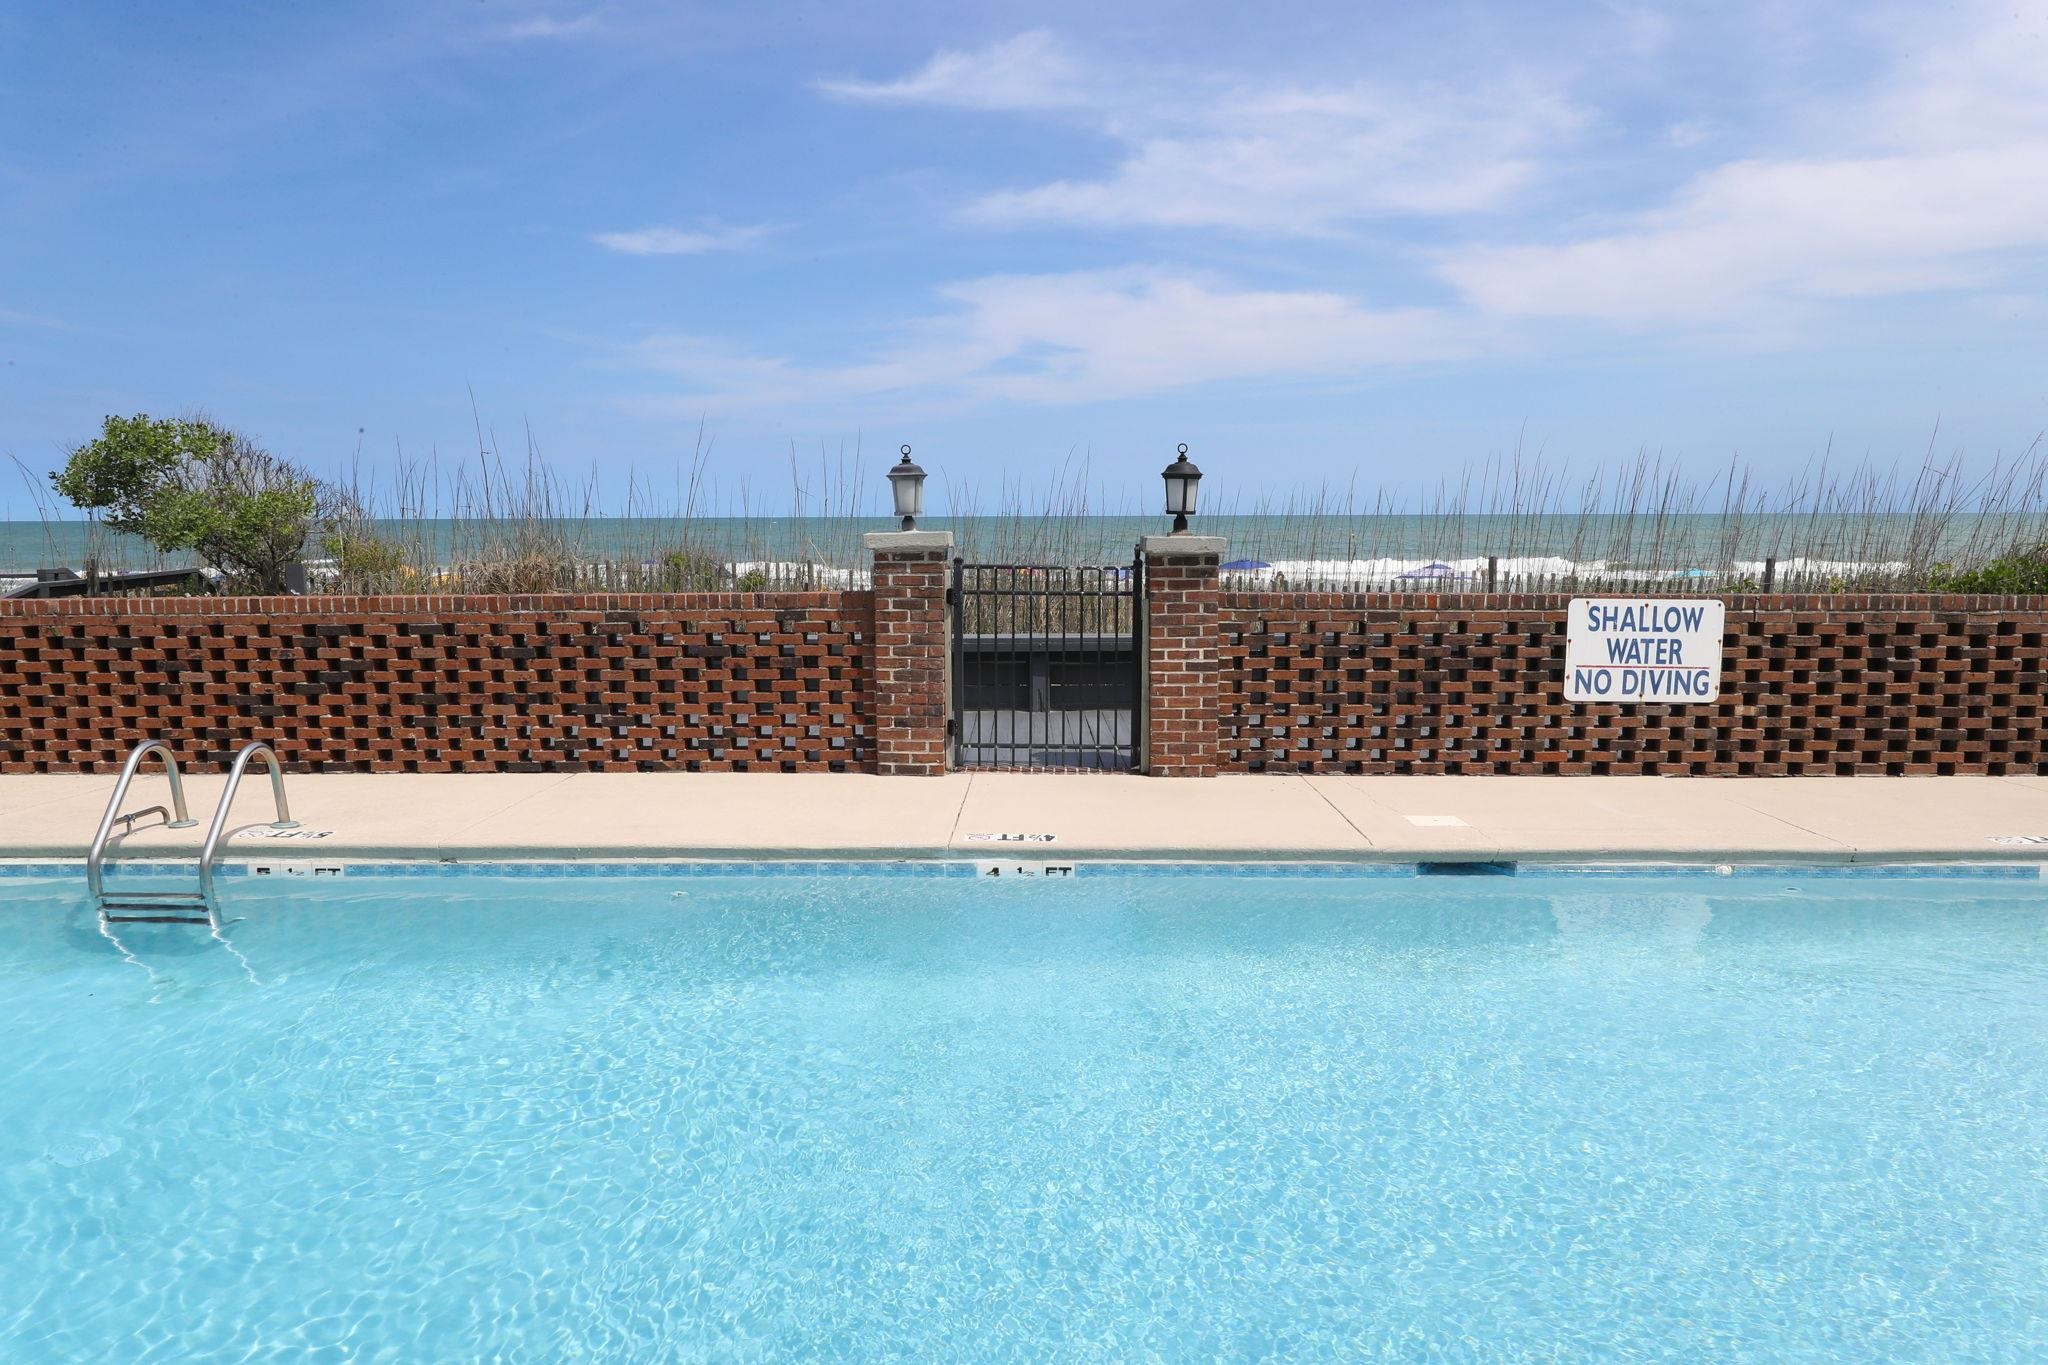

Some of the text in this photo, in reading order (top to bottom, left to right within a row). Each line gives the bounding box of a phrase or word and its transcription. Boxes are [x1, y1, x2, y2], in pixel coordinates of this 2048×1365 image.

[1588, 605, 1704, 633] SHALLOW
[1606, 638, 1683, 665] WATER
[1574, 669, 1710, 696] NO DIVING
[314, 867, 341, 876] FT
[985, 867, 1000, 877] 4
[1045, 867, 1072, 876] FT
